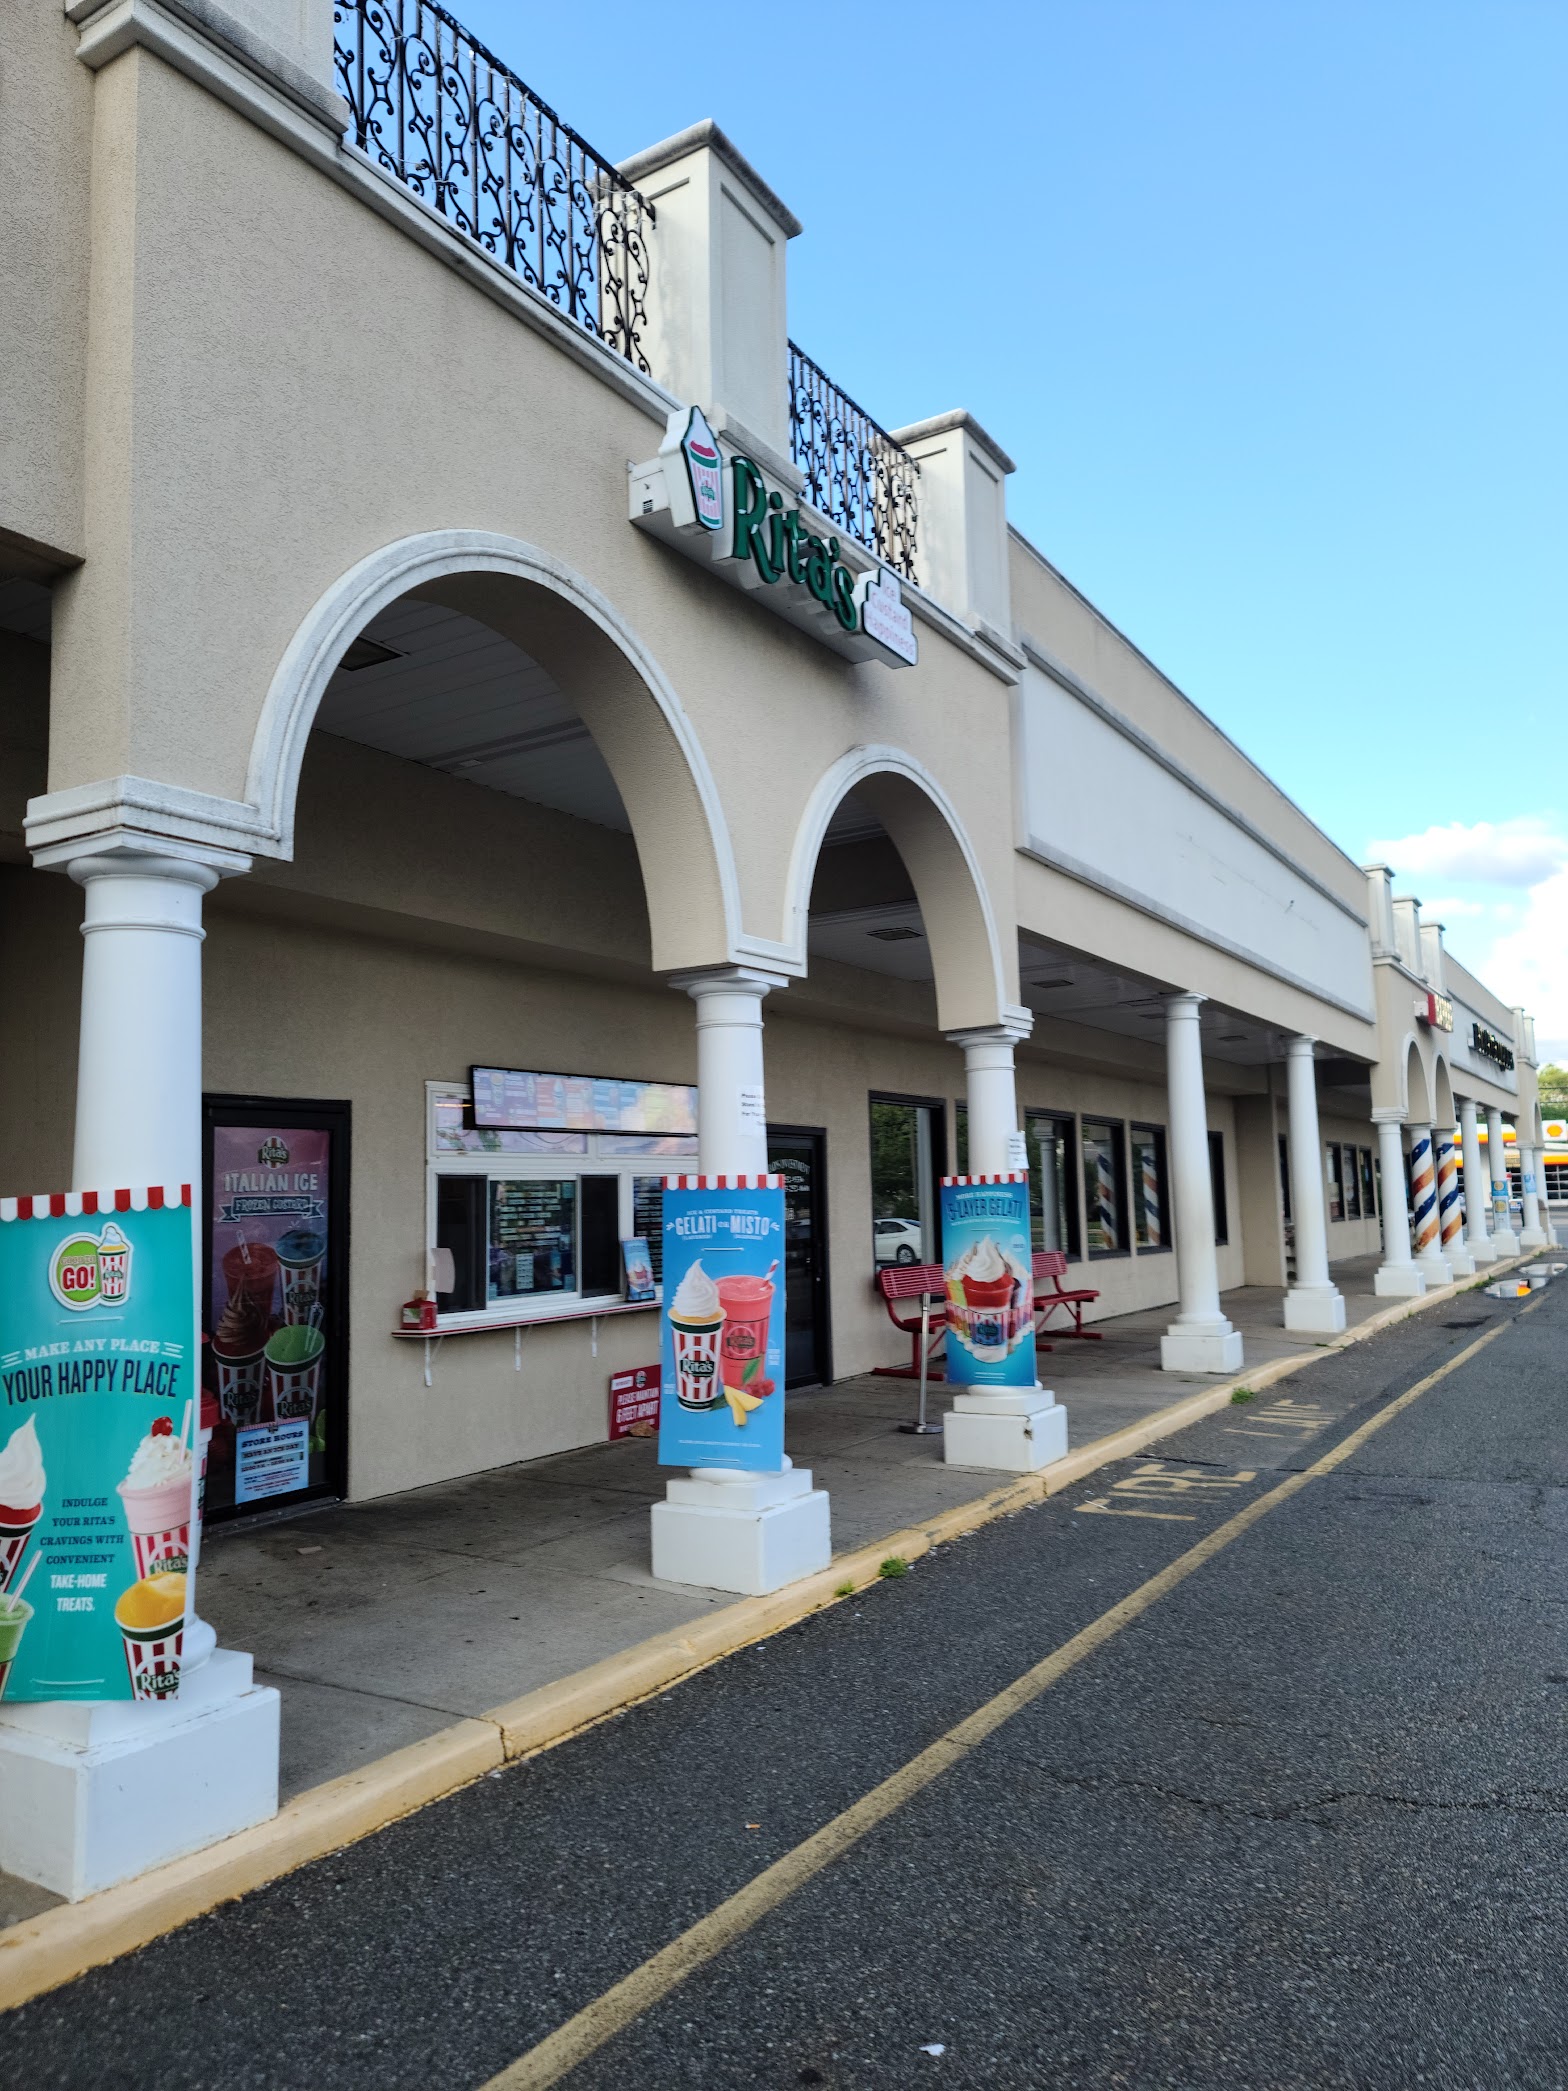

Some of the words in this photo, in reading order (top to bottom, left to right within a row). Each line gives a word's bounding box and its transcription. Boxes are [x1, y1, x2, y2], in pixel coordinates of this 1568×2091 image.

[731, 456, 856, 631] Rita's
[262, 1146, 288, 1160] Rita's
[224, 1173, 288, 1192] ITALIAN
[294, 1173, 318, 1191] ICE
[235, 1199, 271, 1212] FROZEN
[675, 1215, 717, 1236] GELATI
[730, 1215, 770, 1236] MISTO
[62, 1265, 96, 1291] GO!
[24, 1341, 70, 1361] MAKE
[73, 1339, 107, 1352] ANY
[110, 1339, 161, 1354] PLACE
[682, 1357, 714, 1374] Rita's
[2, 1364, 53, 1406] YOUR
[58, 1358, 119, 1396] HAPPY
[122, 1359, 182, 1398] PLACE
[281, 1399, 311, 1416] Rita's
[241, 1436, 272, 1449] STORE
[273, 1430, 304, 1443] HOURS
[1073, 1463, 1258, 1522] FIRE
[61, 1497, 109, 1508] INDULGE
[52, 1517, 81, 1527] YOUR
[83, 1515, 116, 1526] RITA'S
[40, 1535, 93, 1547] CRAVINGS
[95, 1534, 125, 1544] WITH
[46, 1554, 116, 1565] CONVENIENT
[155, 1554, 188, 1573] Rita's
[50, 1573, 108, 1589] TAKE-HOME
[56, 1597, 96, 1612] TREATS.
[140, 1668, 180, 1692] Rita's
